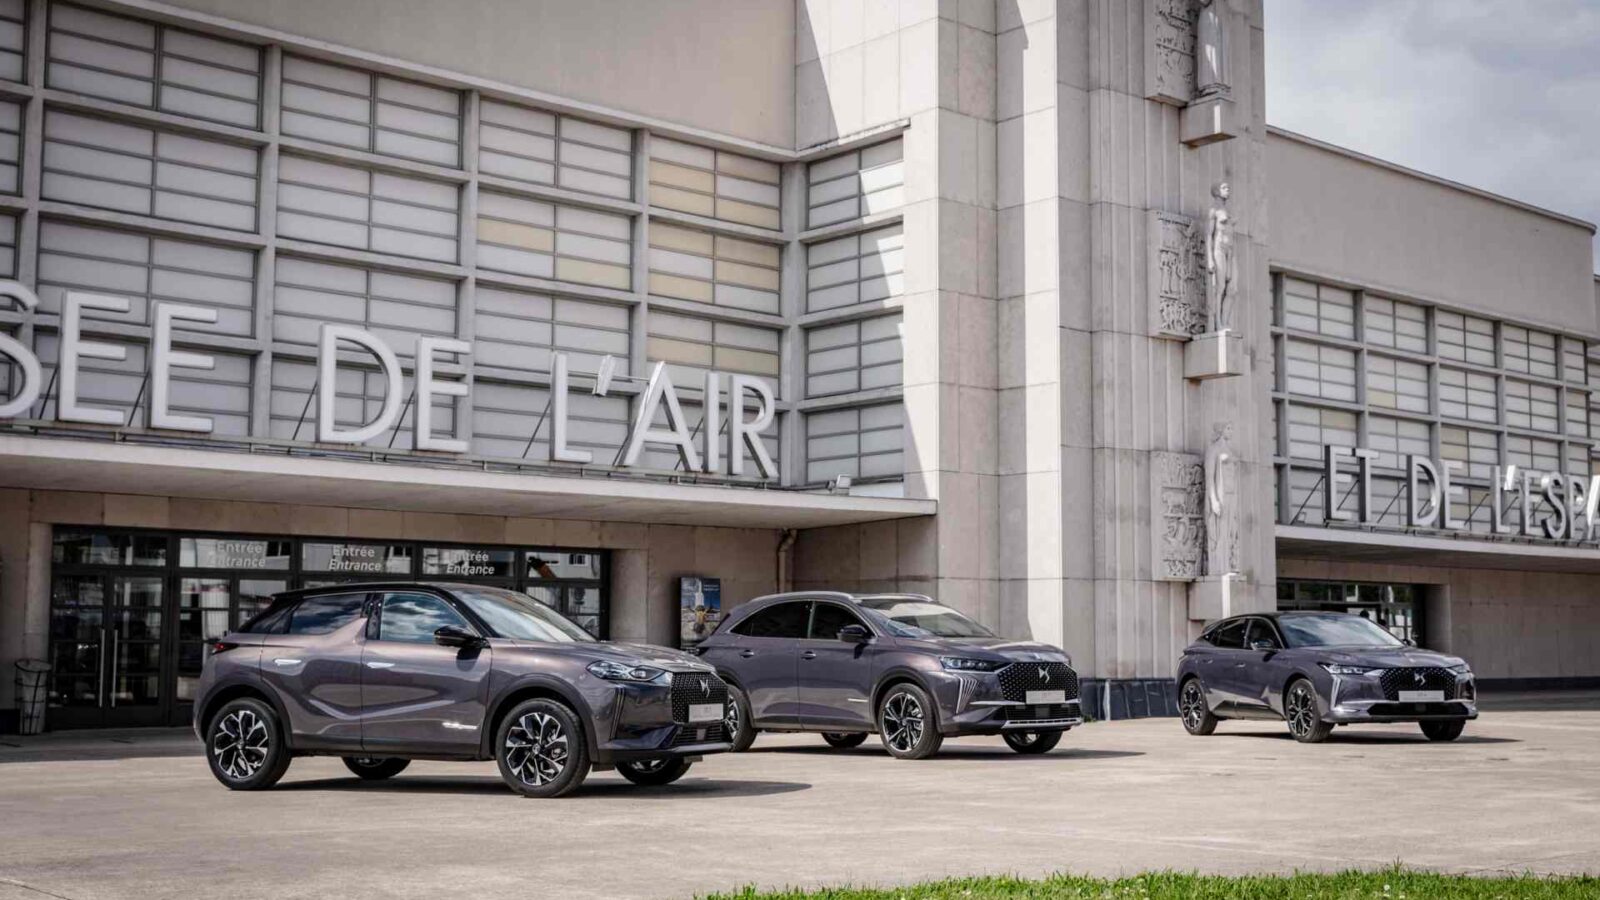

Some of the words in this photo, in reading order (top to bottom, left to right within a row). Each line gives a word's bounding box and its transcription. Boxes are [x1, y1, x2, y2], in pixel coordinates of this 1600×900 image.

[317, 321, 471, 454] DE
[549, 351, 779, 480] L'AIR
[1325, 444, 1380, 522] ET
[1406, 454, 1467, 530] DE
[216, 541, 262, 554] Entrée
[333, 545, 375, 557] Entrée
[450, 550, 489, 565] ntrée
[329, 558, 382, 571] Entrance
[446, 563, 495, 575] Entrance
